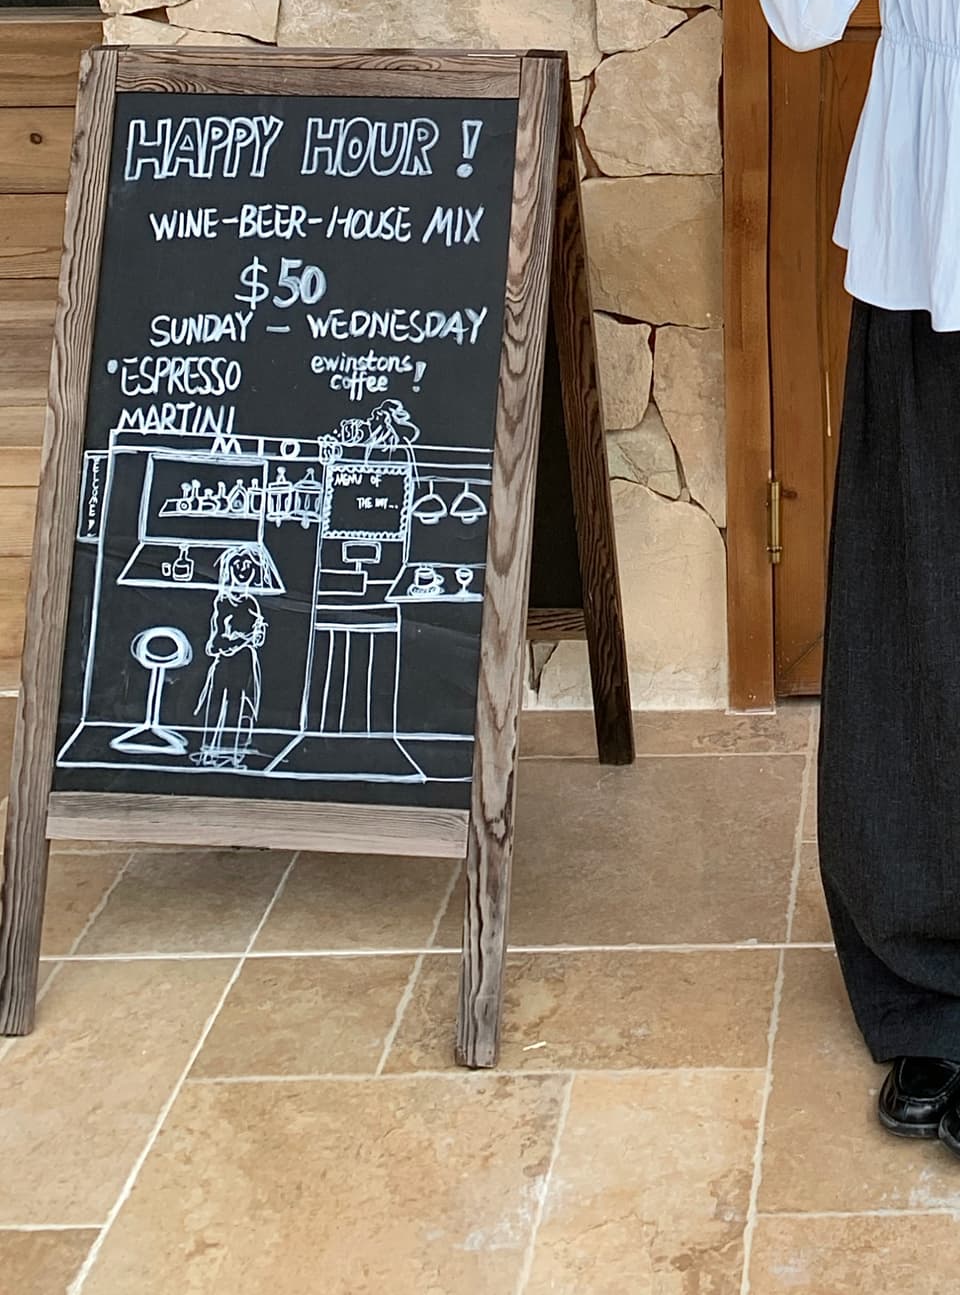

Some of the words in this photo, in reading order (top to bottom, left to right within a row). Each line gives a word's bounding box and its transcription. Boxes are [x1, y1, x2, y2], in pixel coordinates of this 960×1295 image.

[124, 115, 284, 181] HAPPY
[301, 116, 439, 177] HOUR
[422, 204, 485, 247] MIX
[234, 255, 328, 310] $50
[150, 310, 254, 347] SUNDAY
[306, 306, 488, 345] WEDNESDAY
[121, 356, 242, 396] ESPRESSO
[330, 371, 389, 401] coffee
[116, 401, 236, 435] MARTINI
[334, 473, 363, 487] MENU
[370, 474, 383, 488] OF
